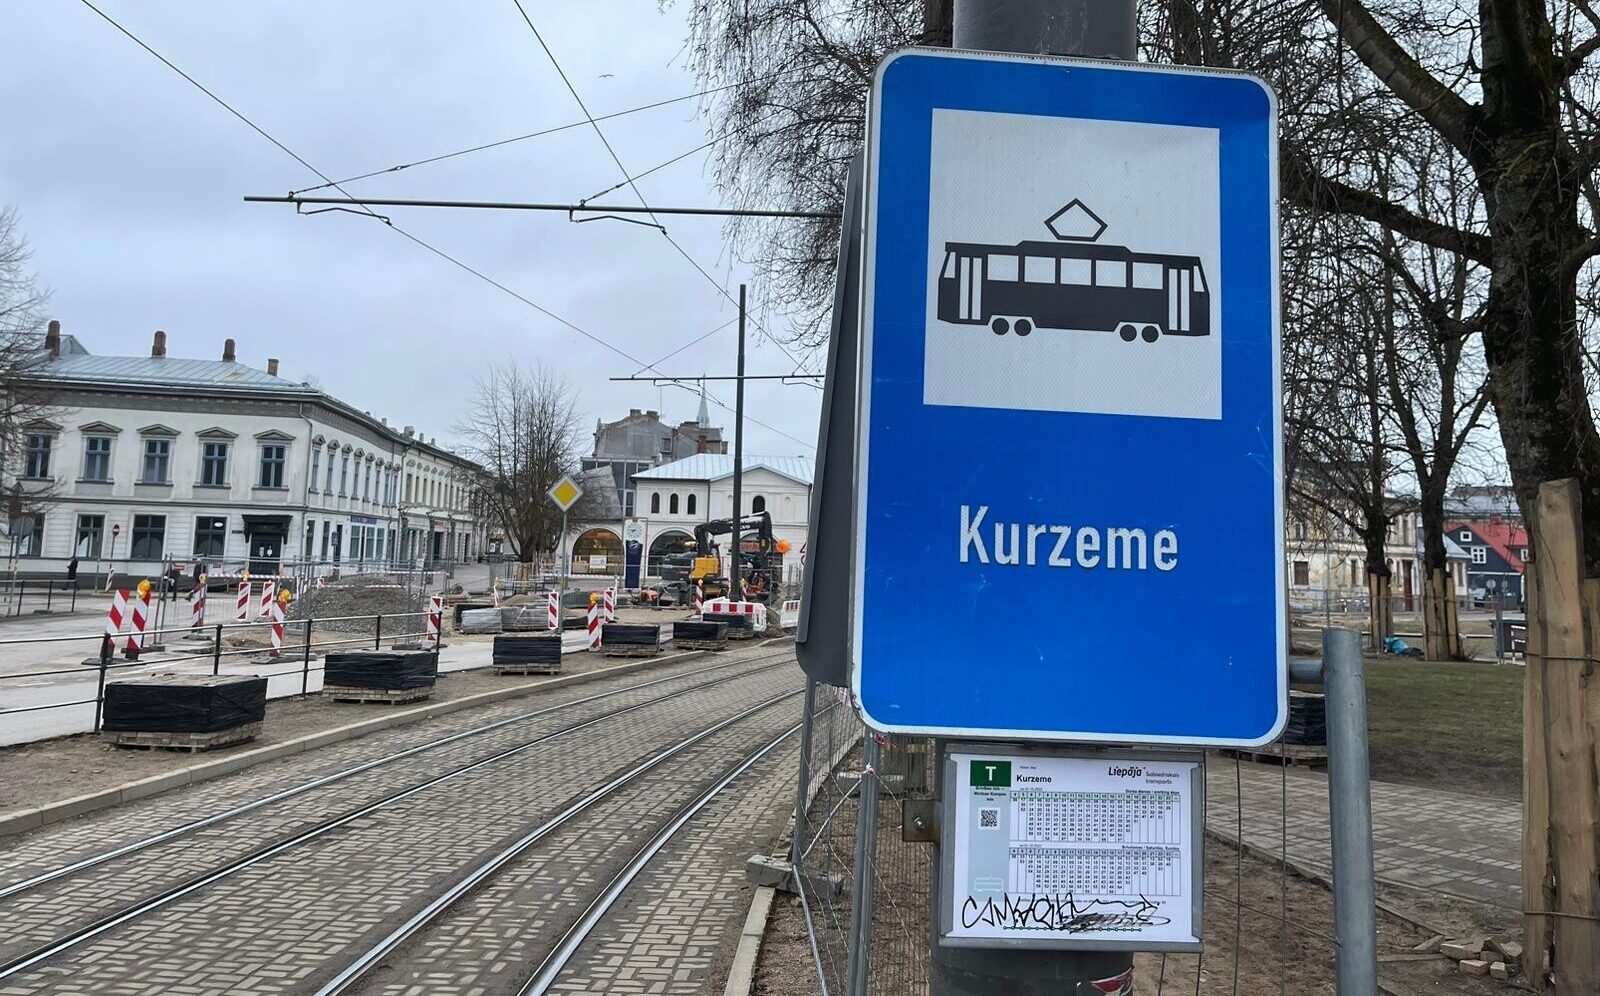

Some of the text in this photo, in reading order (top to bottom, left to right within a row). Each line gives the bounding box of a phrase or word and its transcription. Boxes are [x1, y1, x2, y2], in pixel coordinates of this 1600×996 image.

[959, 504, 1179, 571] Kurzeme
[985, 766, 997, 781] T
[1016, 774, 1053, 783] Kurzeme
[1108, 766, 1143, 778] Liepāja
